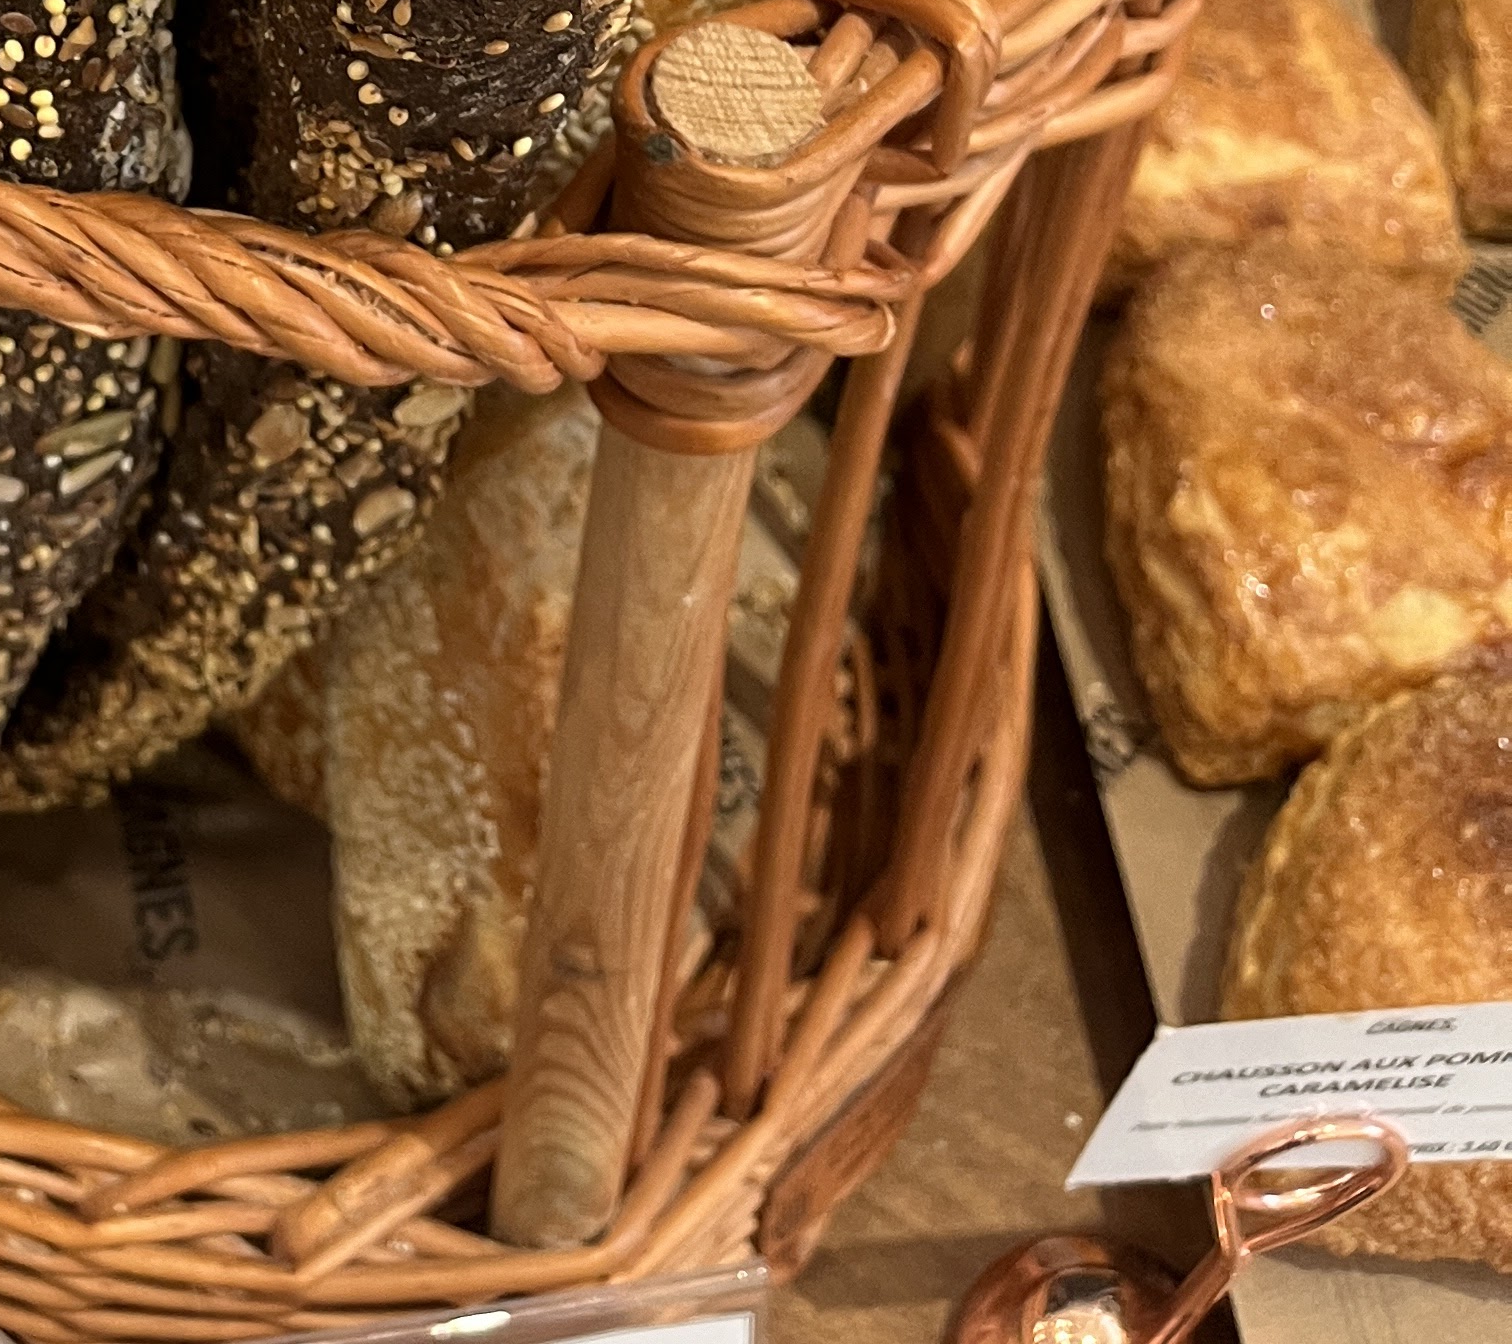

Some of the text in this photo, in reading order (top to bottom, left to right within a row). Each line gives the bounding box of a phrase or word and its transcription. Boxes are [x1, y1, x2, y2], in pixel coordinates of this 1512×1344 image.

[1171, 1060, 1346, 1086] CHAUSSON
[1350, 1054, 1423, 1071] AUX
[1258, 1073, 1457, 1098] CARAMELISE
